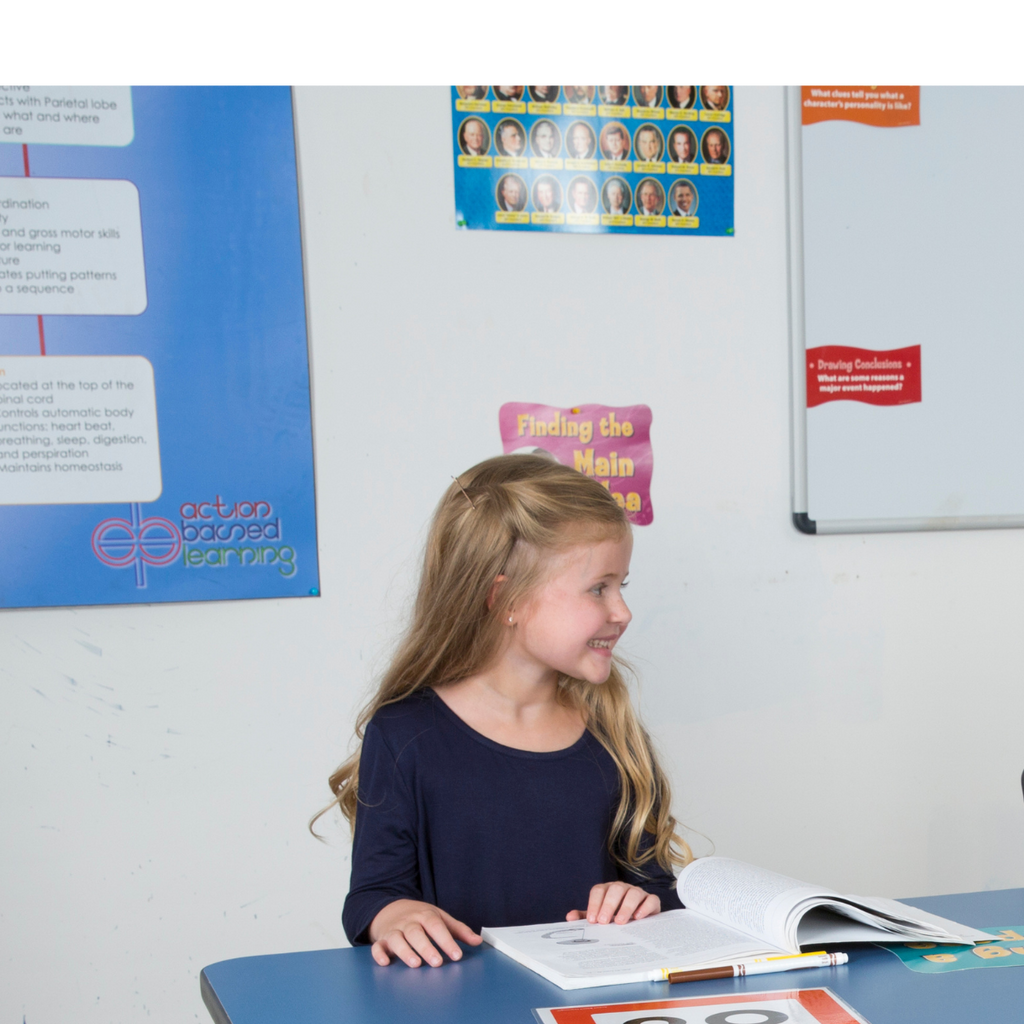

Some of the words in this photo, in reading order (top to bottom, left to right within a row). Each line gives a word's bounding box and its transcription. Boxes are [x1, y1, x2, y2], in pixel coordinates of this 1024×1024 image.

[810, 89, 830, 98] What
[832, 90, 850, 98] clues
[852, 90, 864, 98] tell
[865, 92, 879, 100] you
[880, 92, 898, 100] what
[16, 96, 41, 107] with
[44, 97, 88, 109] Parietal
[91, 99, 118, 110] lobe
[803, 99, 844, 108] character's
[844, 101, 886, 111] personality
[887, 102, 894, 110] is
[894, 102, 912, 110] like?
[3, 111, 33, 122] what
[36, 112, 60, 122] and
[63, 113, 100, 124] where
[3, 126, 22, 136] are
[2, 228, 26, 238] and
[28, 229, 58, 240] gross
[61, 229, 95, 239] motor
[98, 229, 121, 240] skills
[14, 241, 62, 254] learning
[26, 270, 67, 282] putting
[70, 271, 117, 281] patterns
[16, 284, 75, 296] sequence
[818, 359, 853, 373] Drawing
[854, 357, 902, 370] Conclusions
[817, 374, 838, 382] What
[870, 374, 898, 382] reasons
[42, 381, 53, 390] at
[57, 380, 76, 390] the
[79, 381, 98, 392] top
[101, 380, 112, 390] of
[116, 380, 134, 390] the
[819, 384, 841, 394] major
[842, 384, 862, 392] event
[863, 382, 903, 393] happened?
[26, 394, 54, 404] cord
[42, 408, 101, 418] automatic
[104, 407, 134, 419] body
[51, 421, 81, 432] heart
[517, 411, 593, 444] Finding
[599, 412, 634, 437] the
[22, 448, 90, 461] perspiration
[55, 462, 123, 472] homeostasis
[573, 448, 634, 477] Main
[179, 495, 271, 520] action
[182, 543, 297, 577] learning
[922, 953, 958, 963] a
